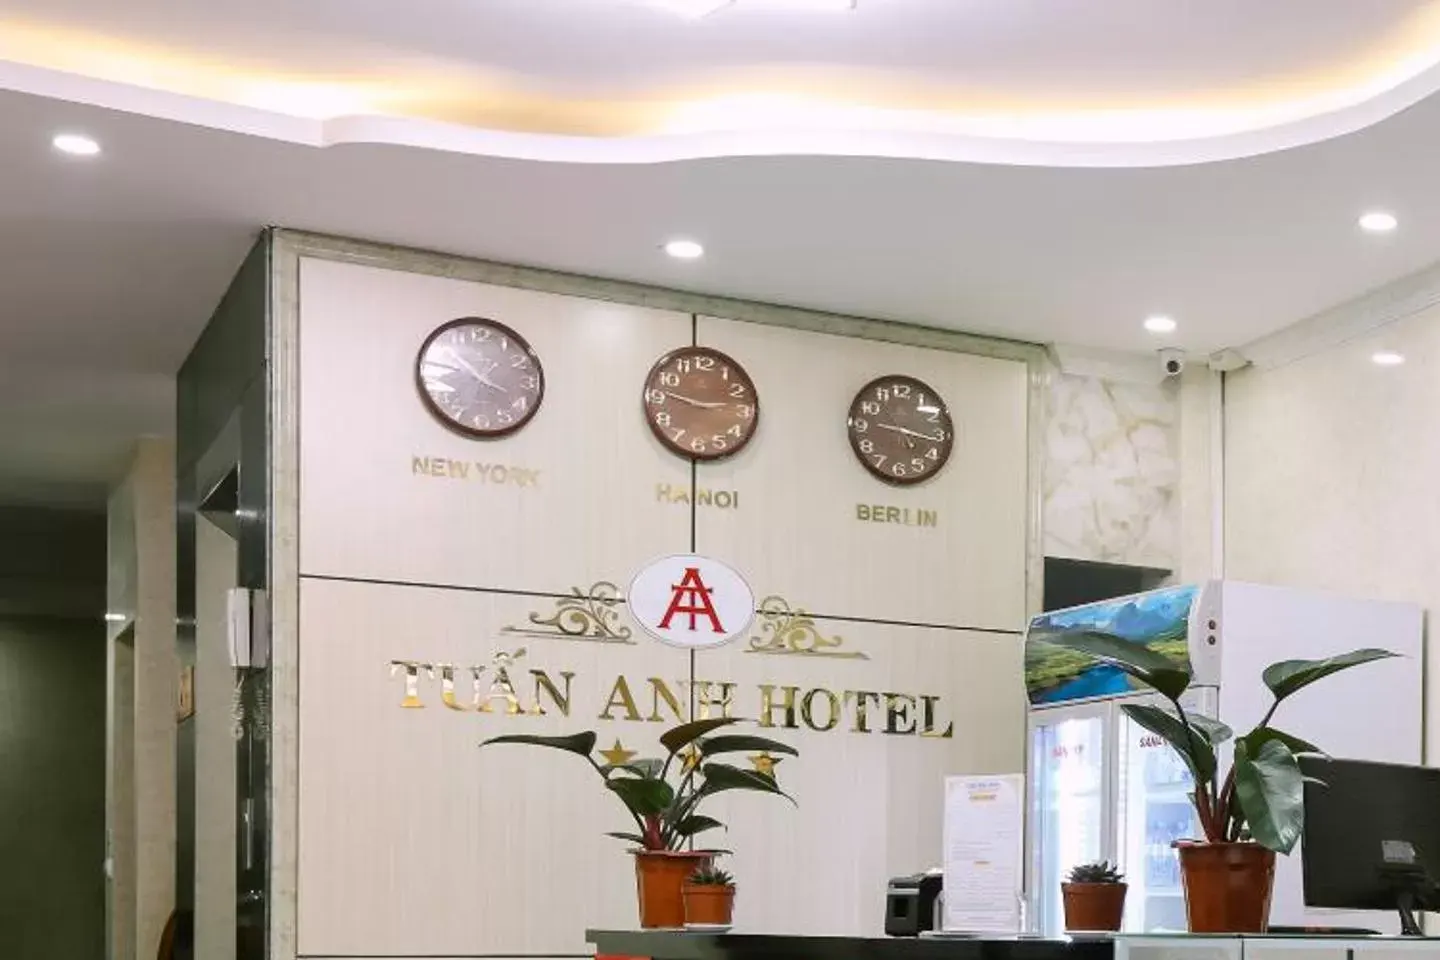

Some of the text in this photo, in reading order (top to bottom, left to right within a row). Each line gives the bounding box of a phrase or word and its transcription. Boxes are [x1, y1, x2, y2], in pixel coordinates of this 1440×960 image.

[510, 354, 528, 369] 2
[676, 358, 690, 373] 11
[693, 356, 715, 371] 12
[660, 372, 680, 387] 10
[722, 366, 729, 380] 1
[651, 389, 665, 404] 9
[728, 383, 746, 398] 2
[875, 387, 890, 402] 11
[892, 385, 911, 400] 12
[918, 393, 925, 406] 1
[736, 404, 749, 418] 3
[862, 401, 880, 415] 10
[656, 412, 671, 427] 8
[854, 418, 868, 432] 9
[670, 427, 686, 441] 7
[727, 425, 741, 437] 4
[933, 428, 945, 442] 3
[690, 437, 705, 452] 6
[712, 435, 726, 449] 5
[860, 440, 873, 454] 8
[873, 454, 887, 468] 7
[925, 447, 938, 461] 4
[412, 455, 541, 487] NEW YORK
[892, 462, 906, 476] 6
[911, 458, 925, 473] 5
[655, 483, 738, 509] HANOI
[856, 503, 938, 527] BERLIN
[391, 648, 953, 738] TUẤN ANH HOTEL
